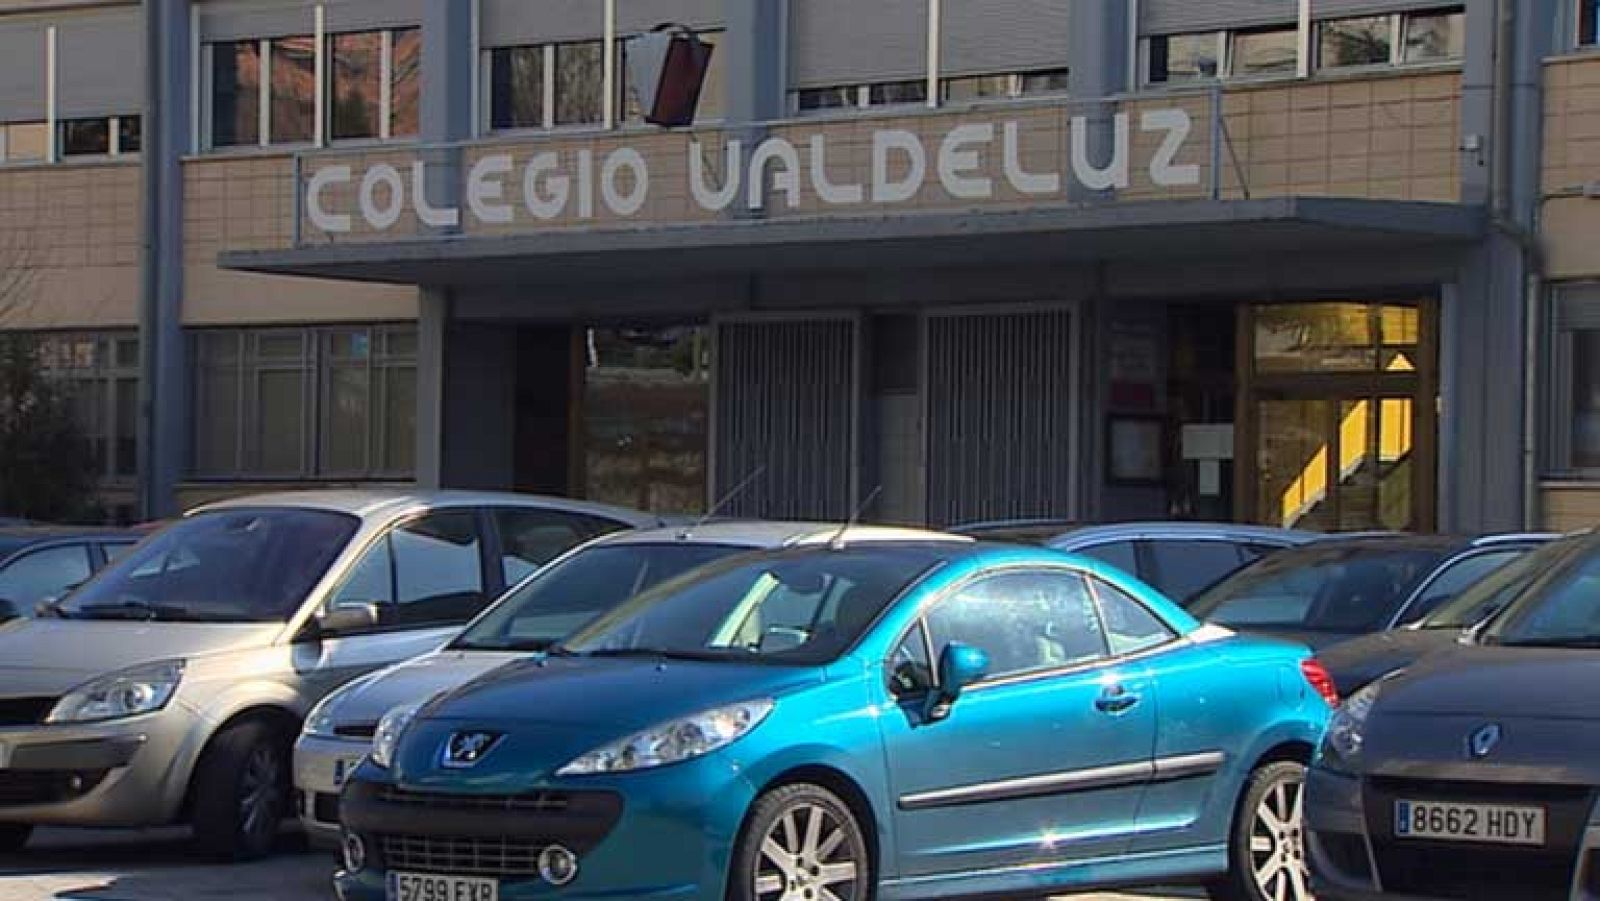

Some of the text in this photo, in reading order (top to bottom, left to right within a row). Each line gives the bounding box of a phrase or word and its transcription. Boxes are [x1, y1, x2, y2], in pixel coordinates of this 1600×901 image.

[307, 108, 1200, 232] COLEGIO VALDELUZ
[1414, 805, 1536, 839] 8662 HDY
[399, 876, 448, 901] 5799
